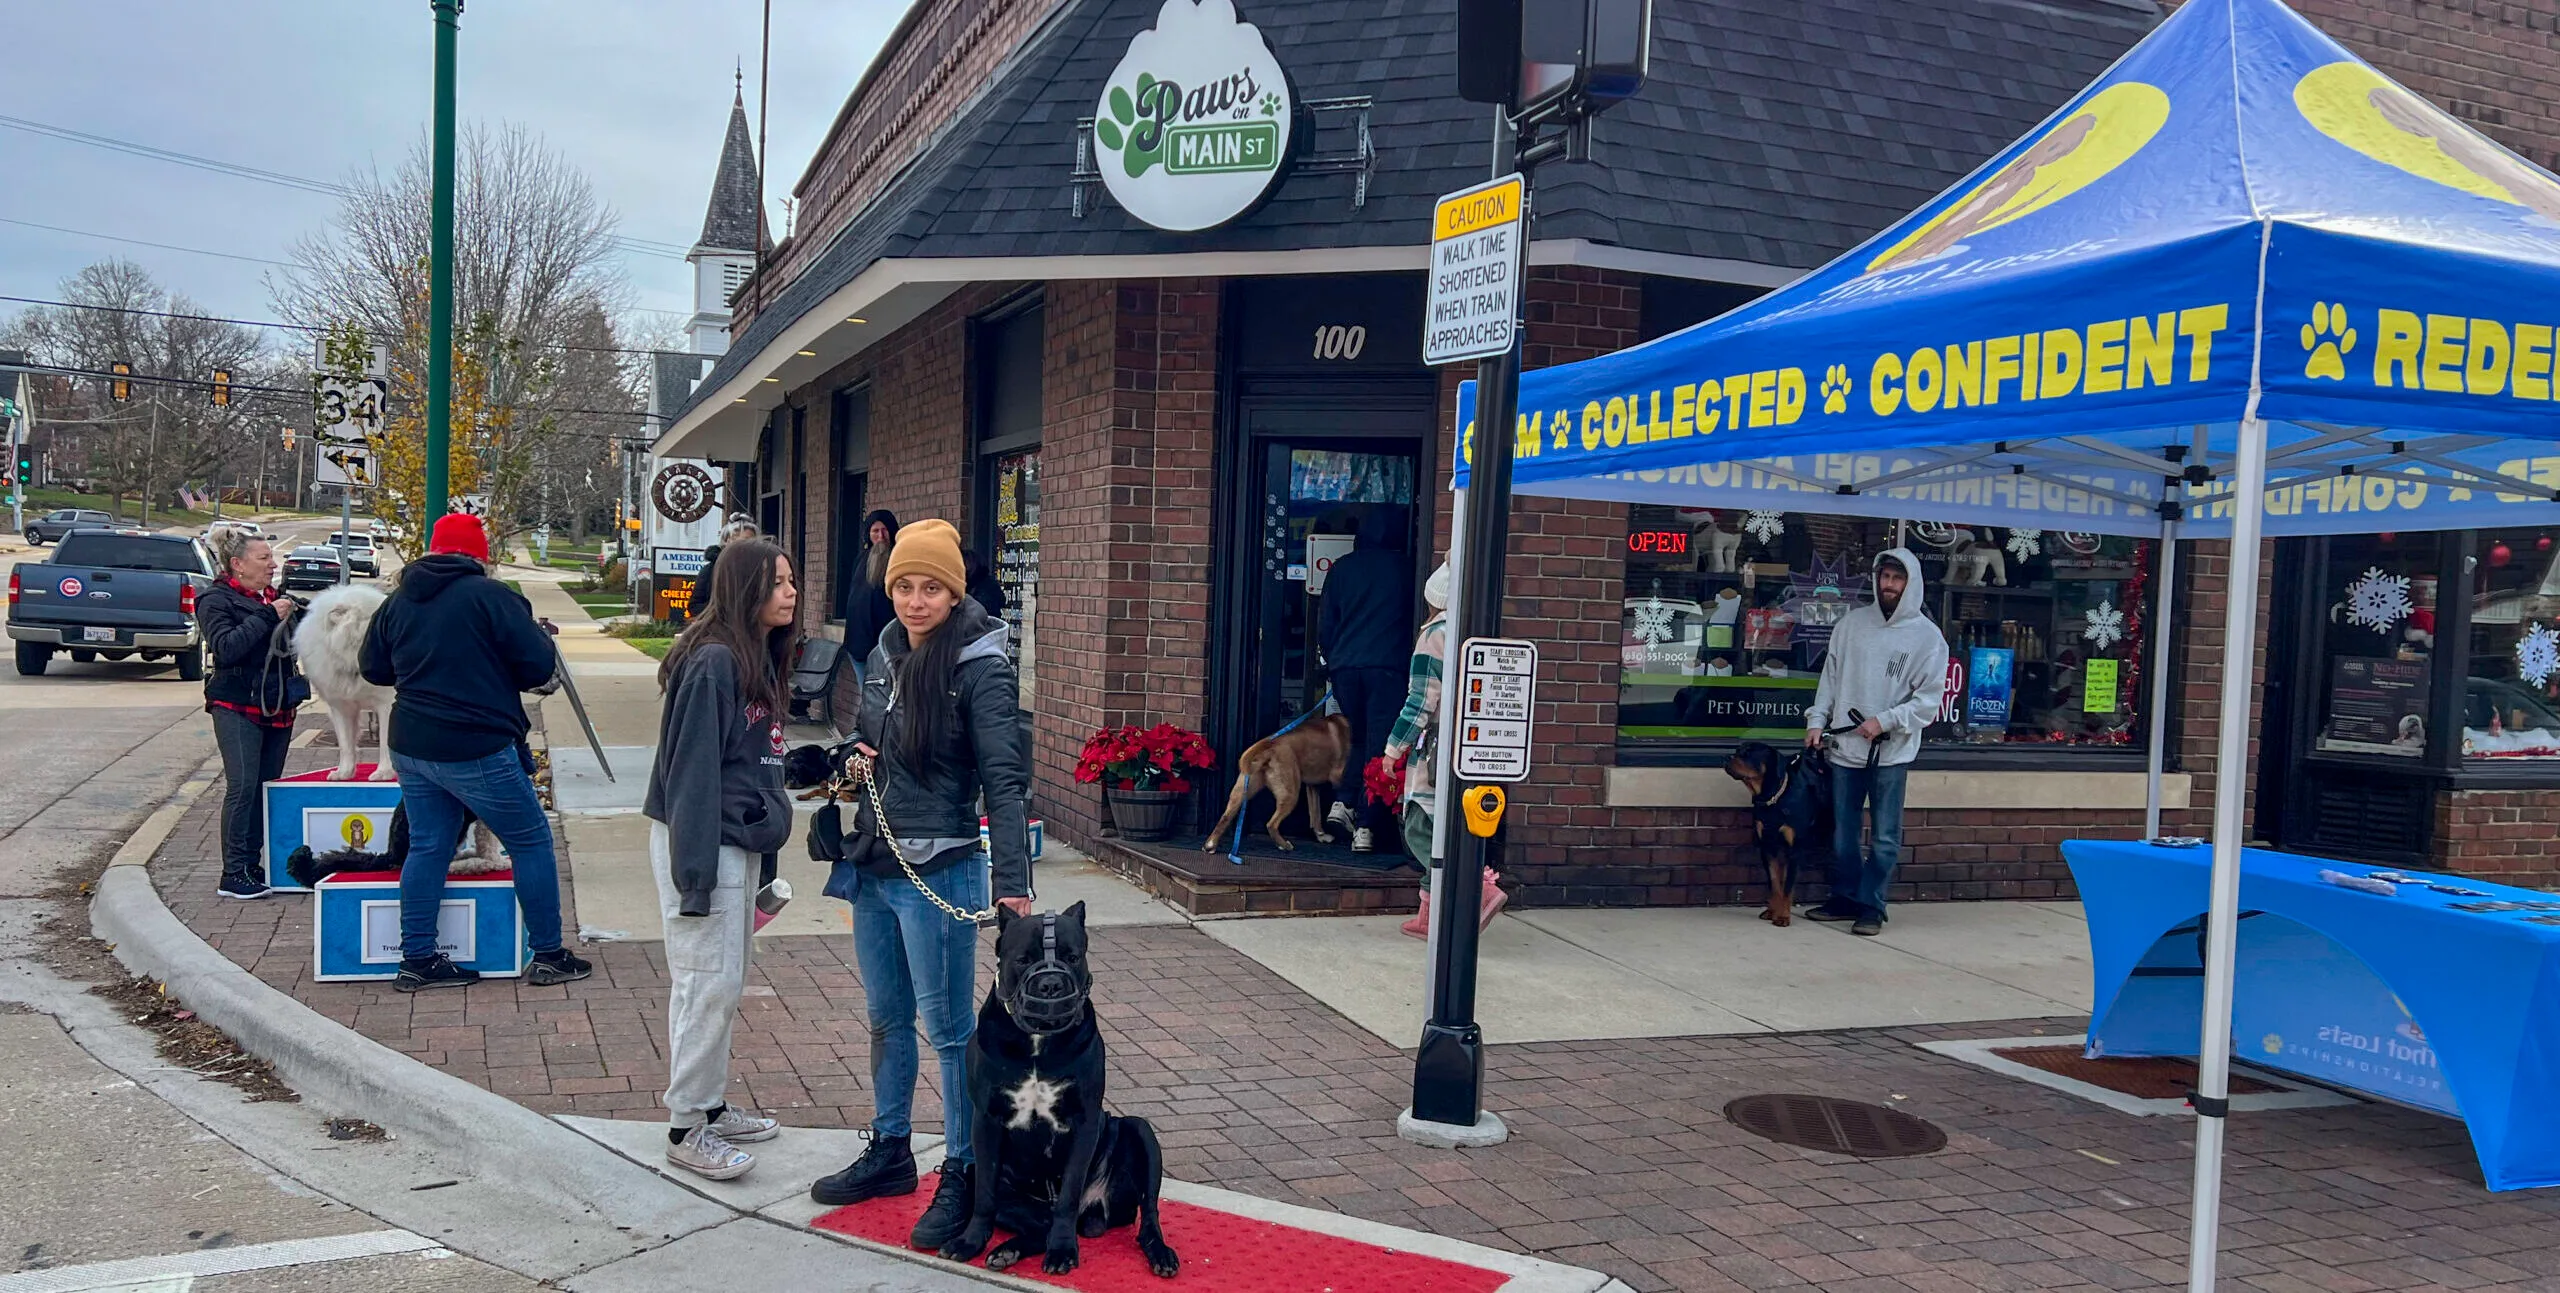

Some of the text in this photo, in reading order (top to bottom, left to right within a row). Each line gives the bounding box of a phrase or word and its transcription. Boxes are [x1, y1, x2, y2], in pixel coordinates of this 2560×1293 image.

[1136, 66, 1261, 152] Paws
[1232, 106, 1250, 120] on
[1179, 132, 1266, 167] MAIN ST
[1449, 192, 1506, 230] CAUTION
[1443, 231, 1507, 266] WALK TIME
[1438, 261, 1506, 295] SHORTENED
[1435, 291, 1507, 324] WHEN TRAIN
[1313, 325, 1366, 360] 100
[1429, 320, 1509, 352] APPROACHES
[2373, 308, 2560, 402] REDE
[1463, 410, 1542, 465] CM
[1581, 366, 1806, 451] COLLECTED
[1870, 303, 2228, 417] CONFIDENT
[1629, 532, 1687, 553] OPEN
[670, 563, 704, 571] LEGIO
[1488, 763, 1506, 771] CROSS
[1491, 751, 1512, 759] BUTTON
